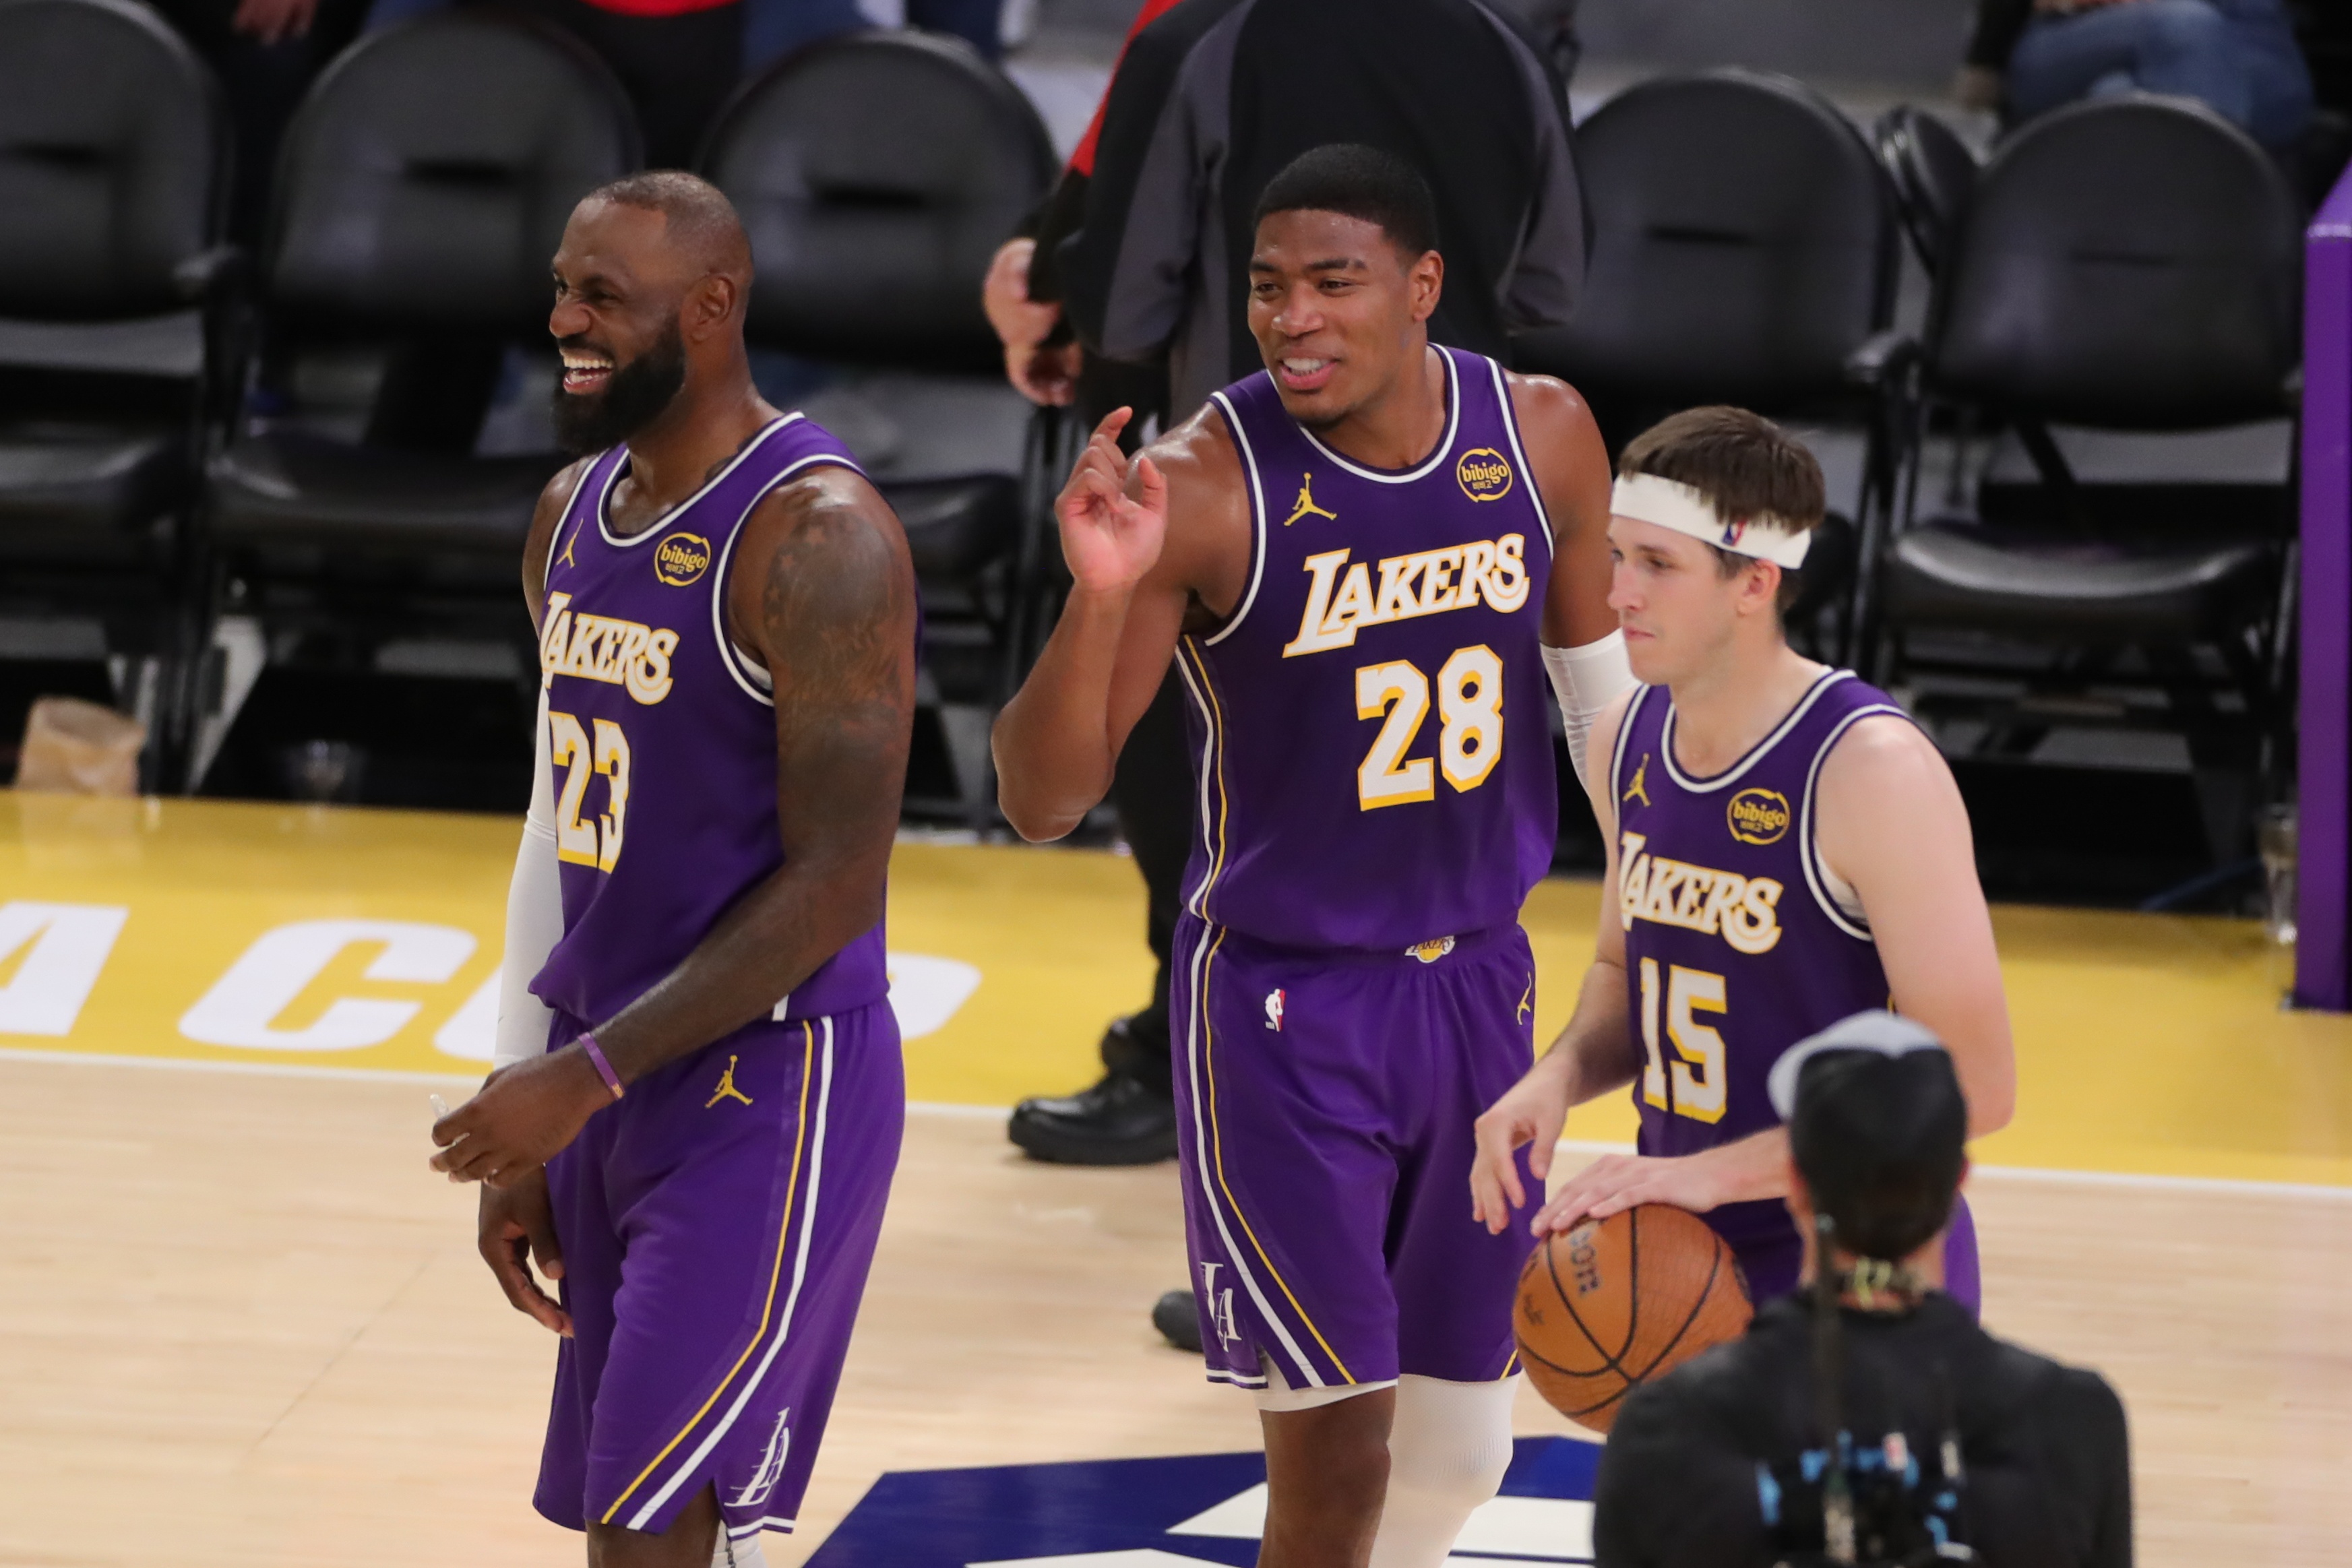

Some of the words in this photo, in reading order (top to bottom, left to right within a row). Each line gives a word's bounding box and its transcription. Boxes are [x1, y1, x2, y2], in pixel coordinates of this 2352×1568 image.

[1461, 462, 1508, 484] bibigo
[660, 544, 706, 573] bibigo
[1282, 533, 1530, 658] LAKERS
[1355, 644, 1504, 811] 28
[549, 710, 631, 874] 23
[1733, 801, 1785, 831] bibigo
[1639, 957, 1727, 1125] 15
